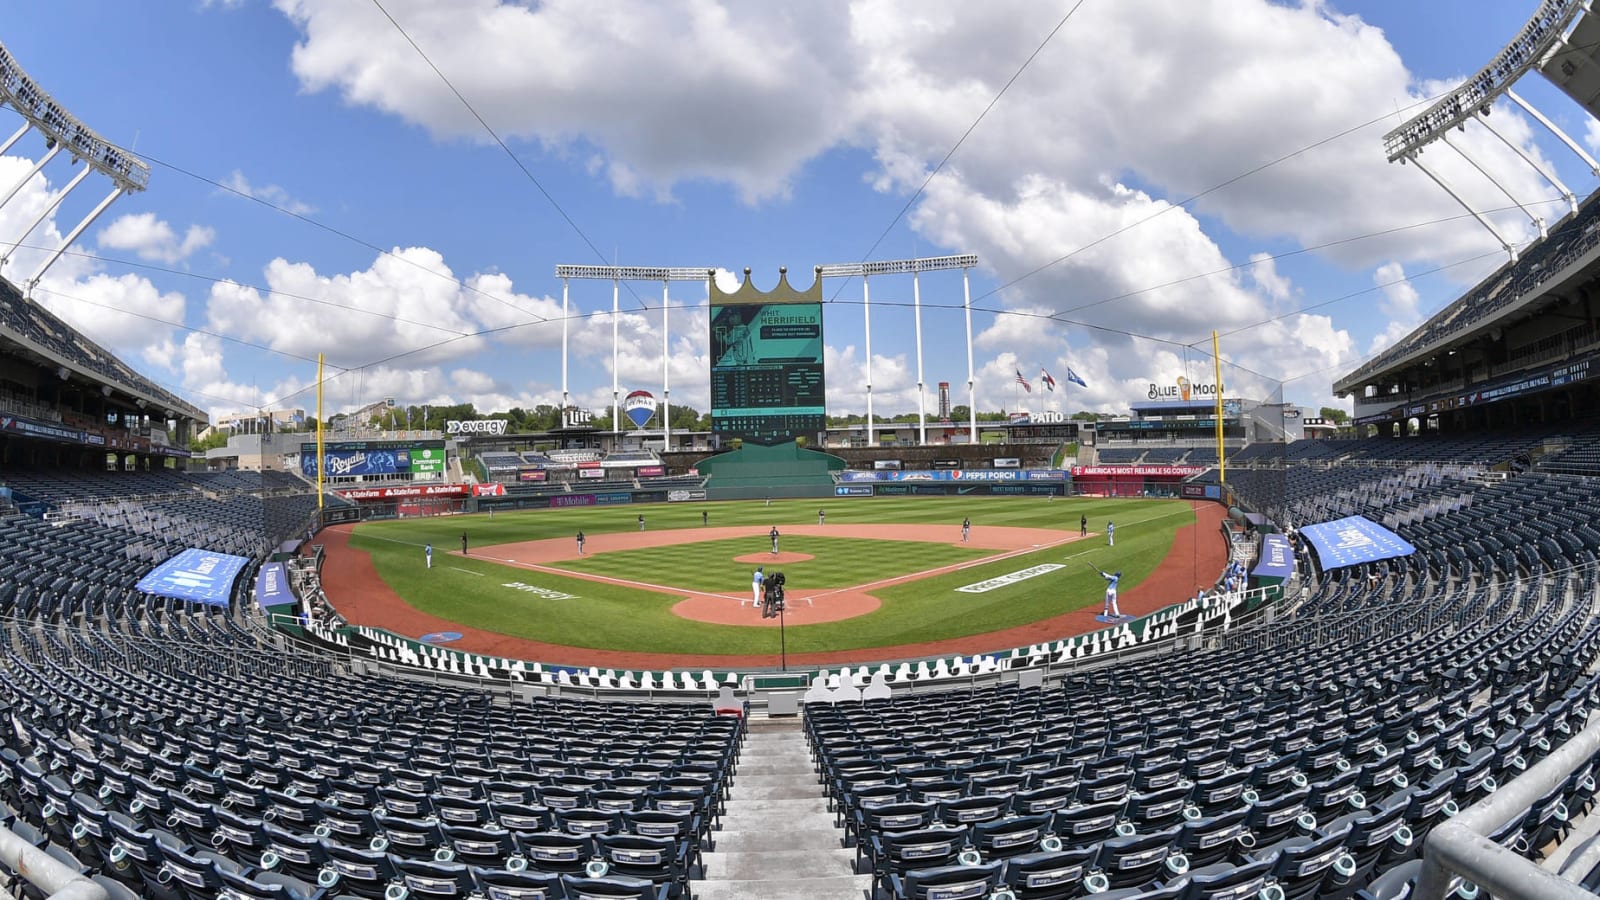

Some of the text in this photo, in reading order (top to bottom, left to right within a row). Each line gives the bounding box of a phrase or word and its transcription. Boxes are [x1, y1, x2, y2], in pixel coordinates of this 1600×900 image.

[1148, 383, 1177, 400] BLUE
[568, 410, 592, 425] Lite
[1030, 411, 1064, 424] PATIO
[462, 420, 507, 434] evergy
[330, 451, 367, 474] Royals
[966, 471, 1016, 480] PEPSI PORCH
[1084, 466, 1116, 475] AMERICA'S
[1116, 466, 1134, 475] MOST
[1135, 466, 1162, 475] RELIABLE
[1163, 466, 1171, 475] 5G
